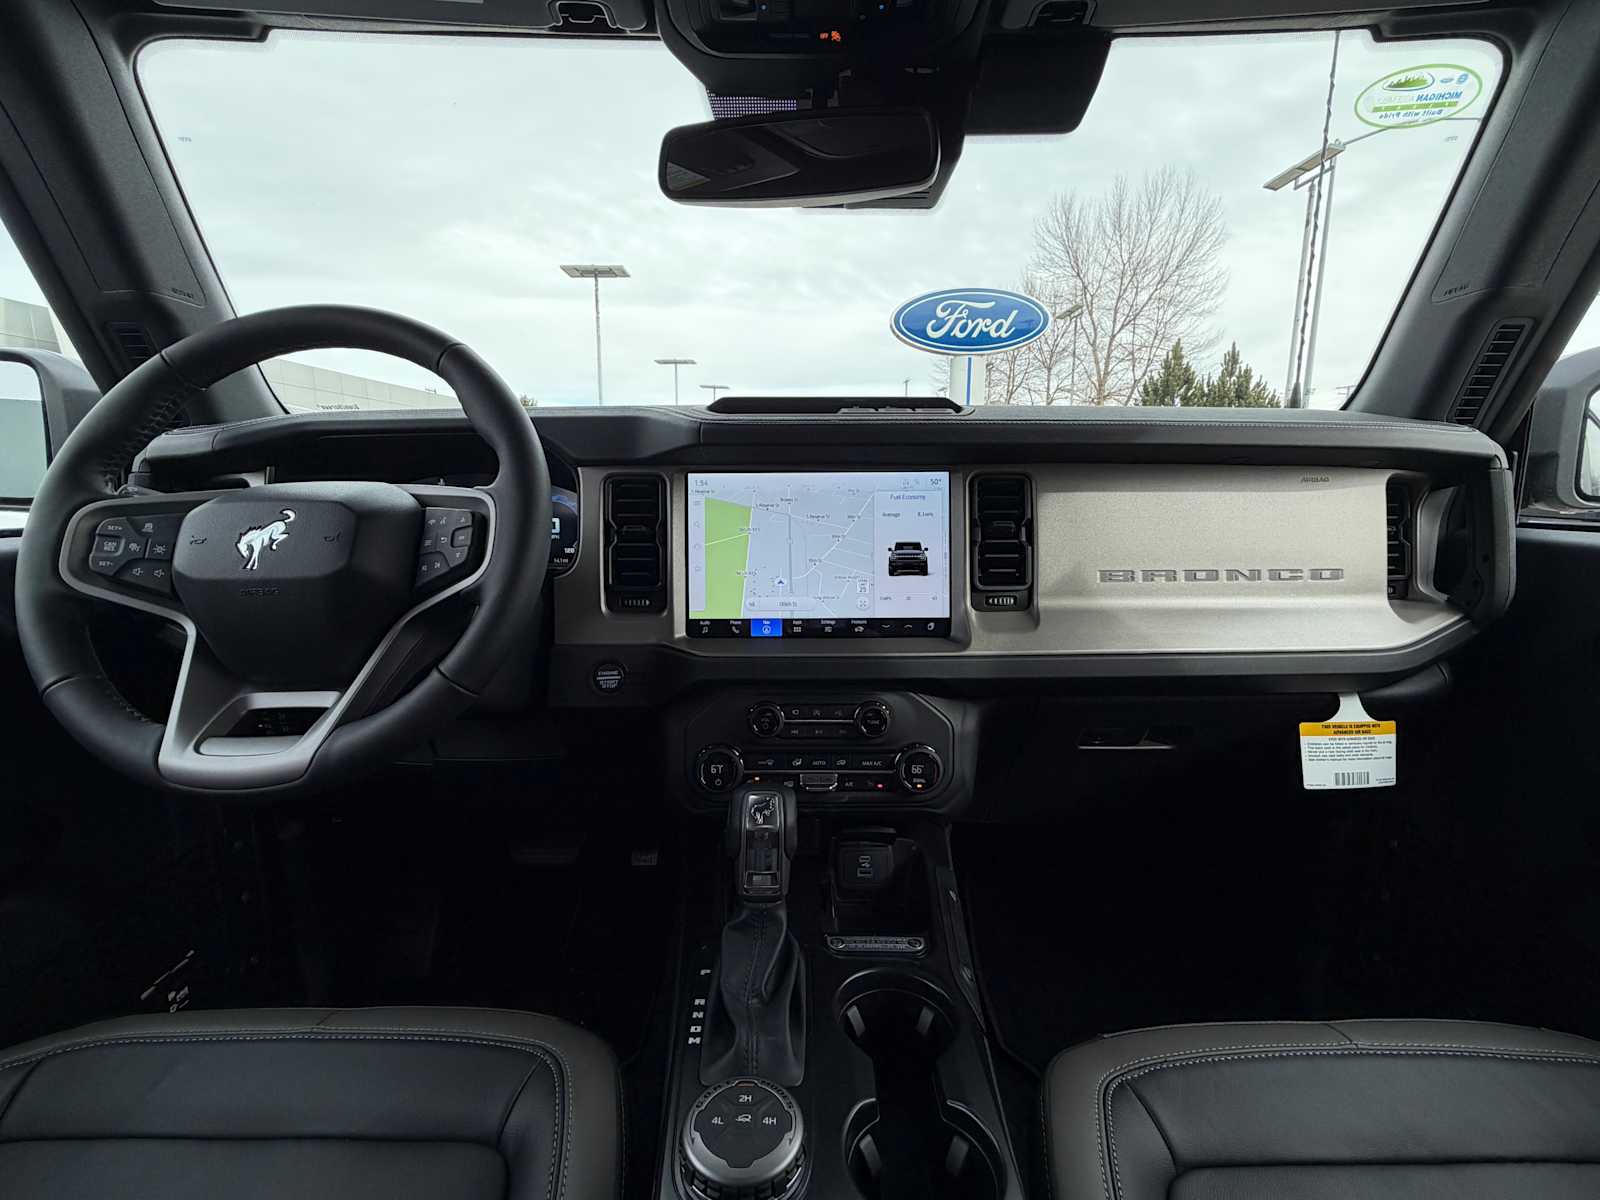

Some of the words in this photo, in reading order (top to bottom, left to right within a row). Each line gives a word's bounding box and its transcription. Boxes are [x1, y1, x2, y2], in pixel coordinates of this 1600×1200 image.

[926, 299, 1019, 339] Ford
[1098, 568, 1344, 583] BRONCO
[692, 1011, 704, 1019] N
[688, 1036, 701, 1045] M
[738, 1094, 752, 1103] 2H
[711, 1116, 725, 1126] 4L
[762, 1116, 777, 1126] 4H
